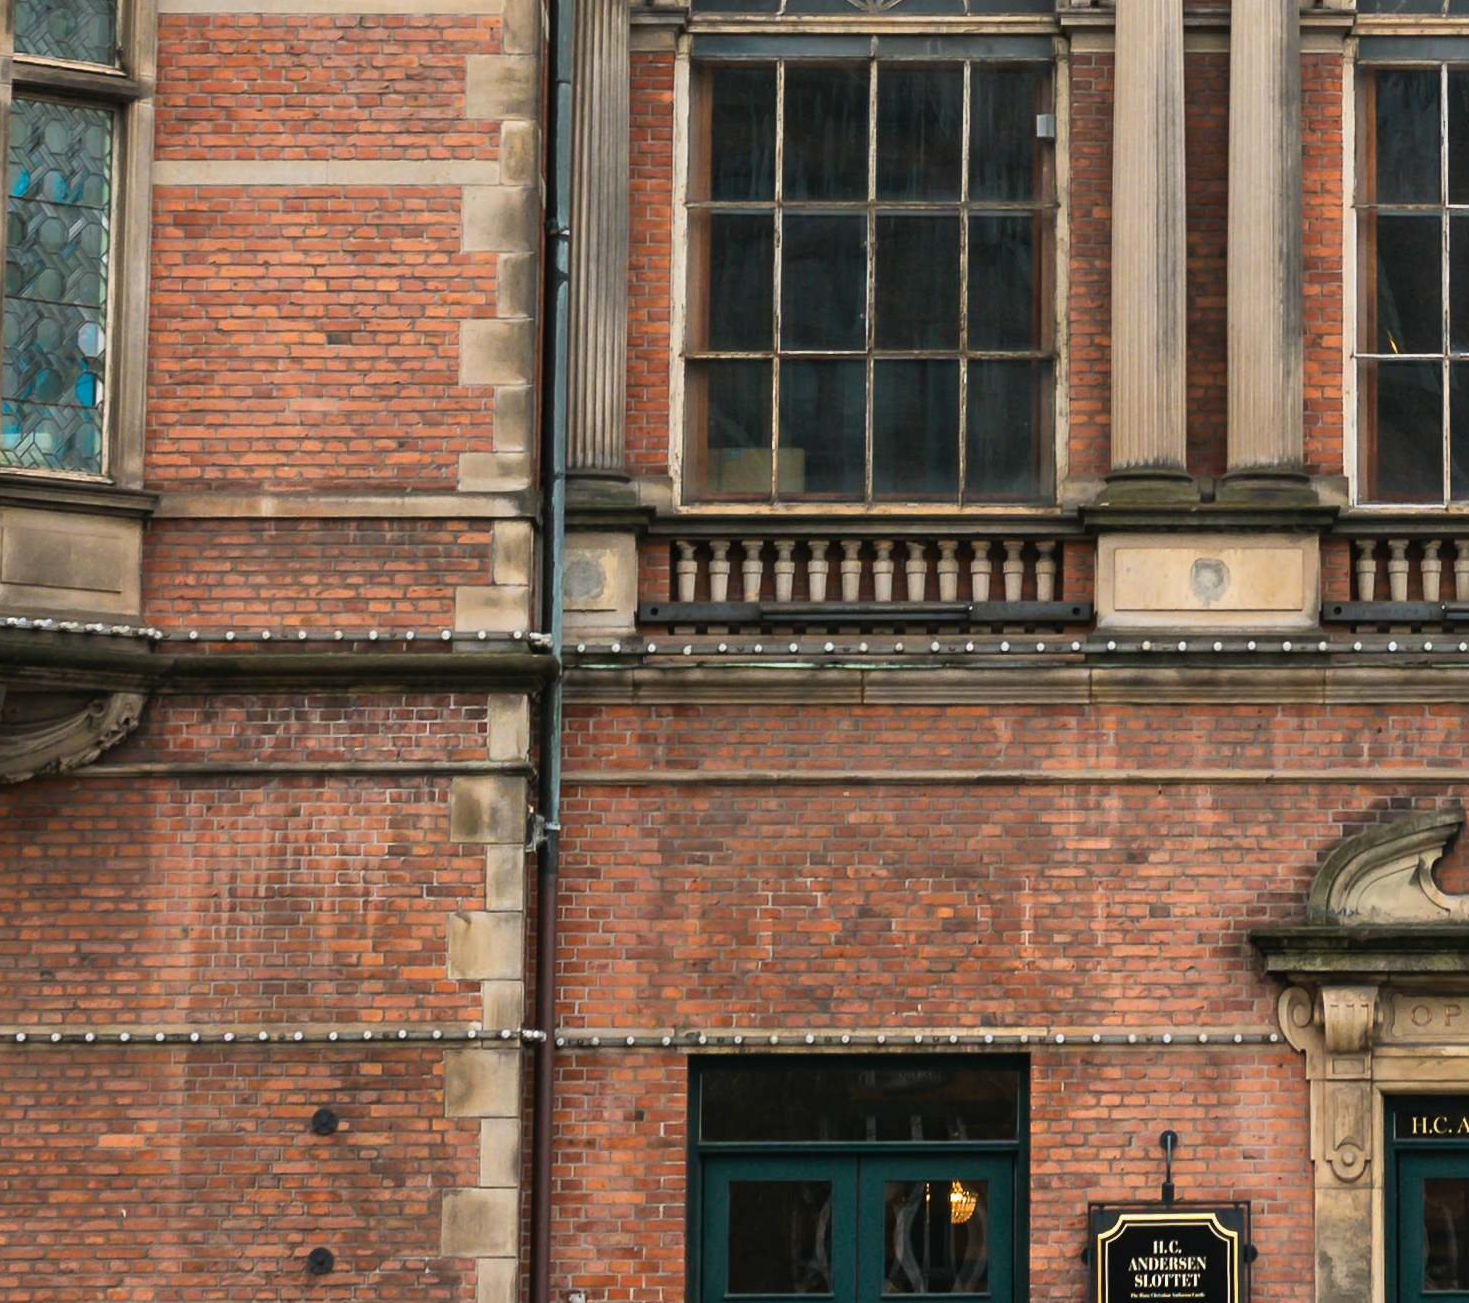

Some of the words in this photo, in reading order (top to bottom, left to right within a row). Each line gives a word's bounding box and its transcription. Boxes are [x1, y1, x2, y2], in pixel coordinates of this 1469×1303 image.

[1411, 1115, 1453, 1135] H.C.
[1152, 1240, 1182, 1254] H.C.
[1128, 1256, 1207, 1271] ANDERSEN
[1134, 1273, 1201, 1288] SLOTTET
